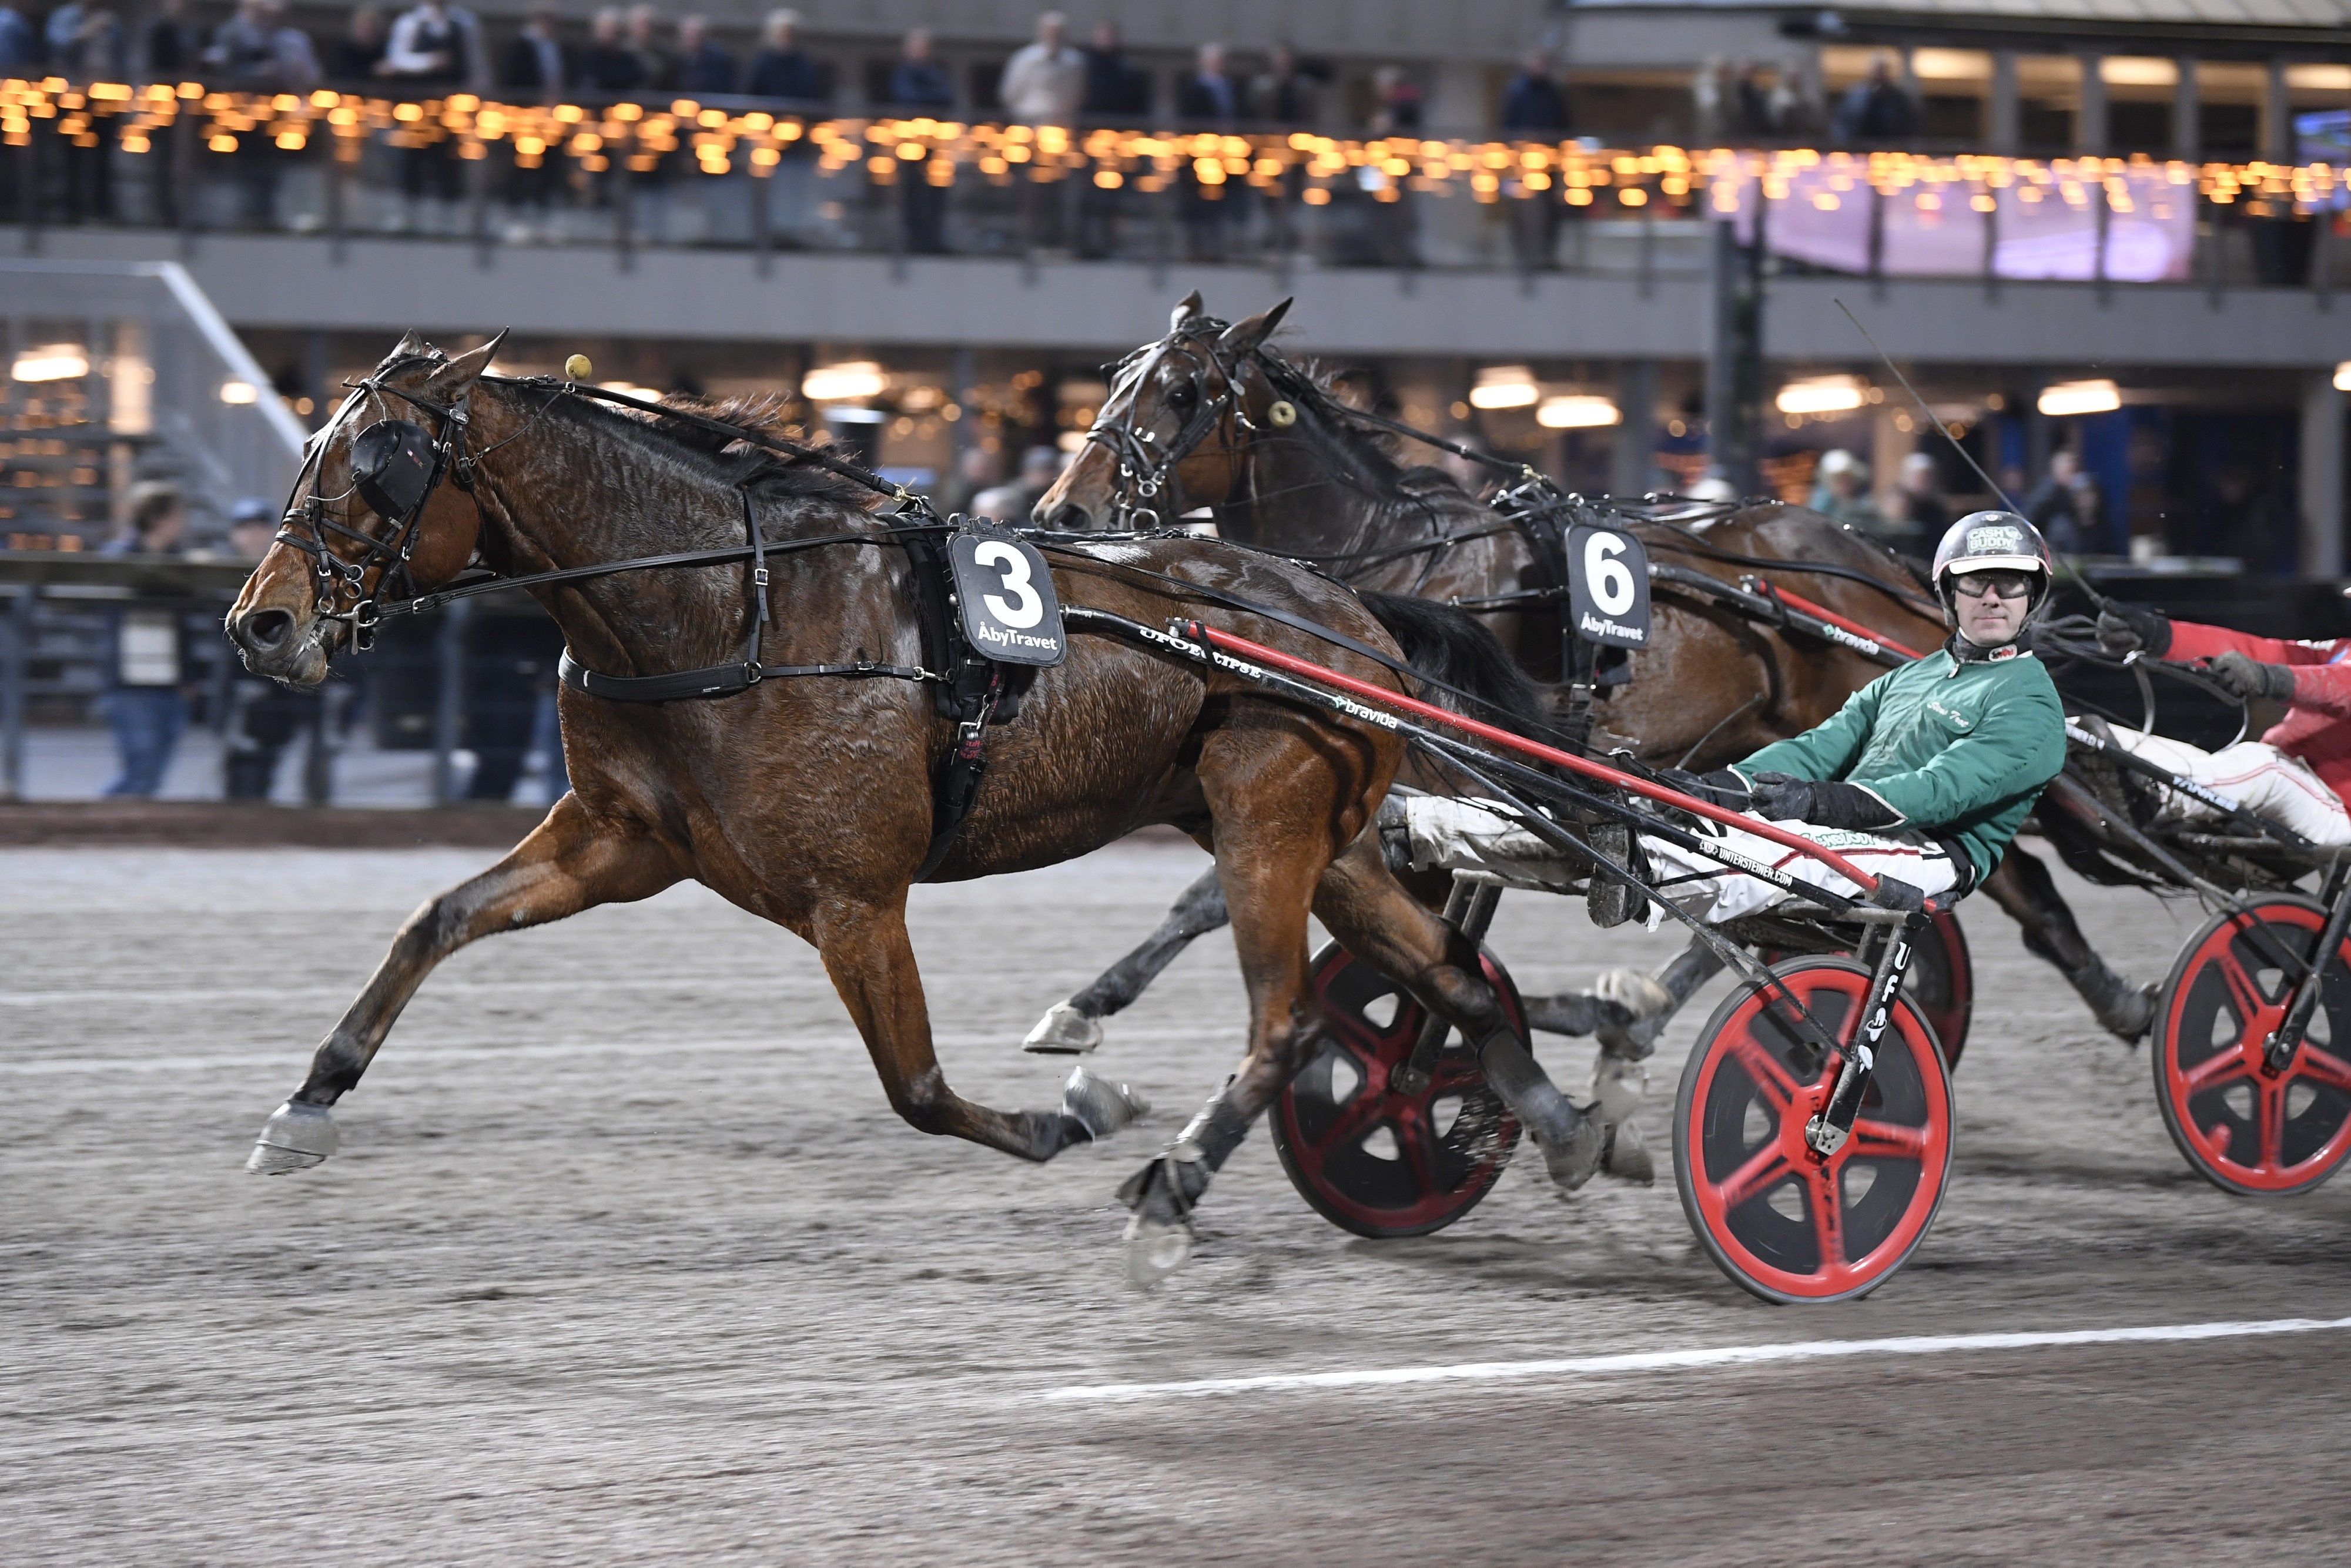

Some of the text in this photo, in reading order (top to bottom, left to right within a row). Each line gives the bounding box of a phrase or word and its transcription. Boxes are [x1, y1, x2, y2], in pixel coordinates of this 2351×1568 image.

[1969, 528, 2004, 540] CASH
[1970, 537, 2013, 550] BUDDY
[974, 541, 1043, 628] 3
[1584, 531, 1635, 615] 6
[978, 621, 1057, 650] ÅbyTravet
[1580, 611, 1643, 641] ÅbyTravet
[1833, 626, 1879, 655] bravida
[1345, 698, 1398, 729] bravida
[1719, 847, 1793, 887] UNTERSTEINER.COM
